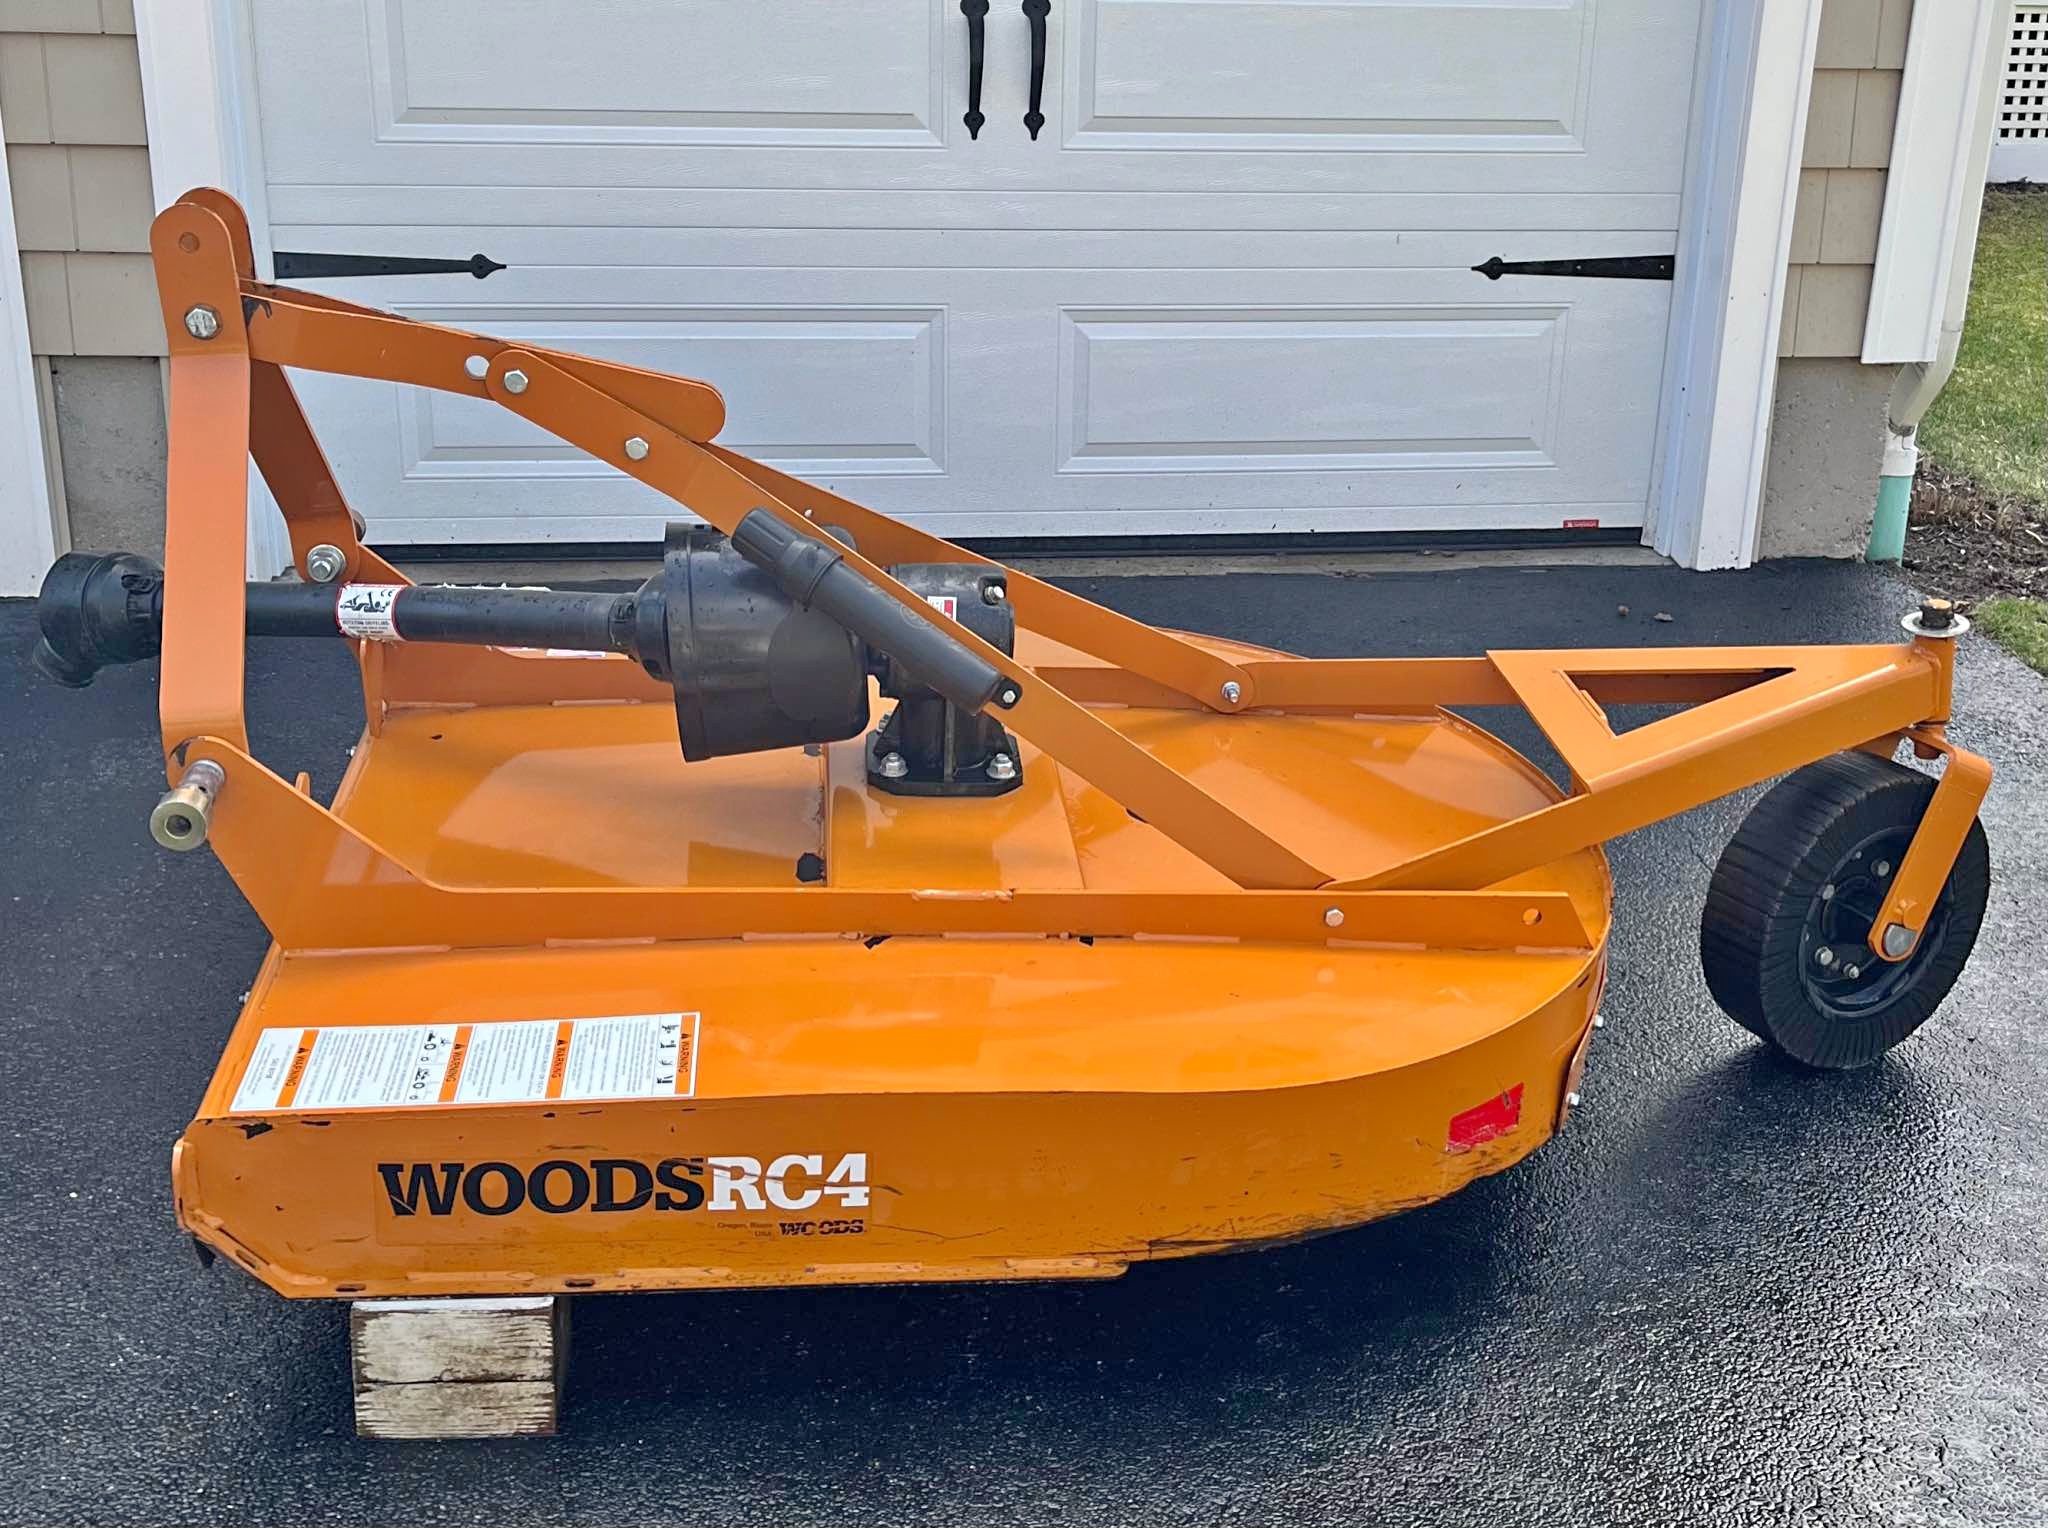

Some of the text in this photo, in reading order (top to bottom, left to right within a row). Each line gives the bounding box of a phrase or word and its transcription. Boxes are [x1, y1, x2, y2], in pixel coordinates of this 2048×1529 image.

[286, 1055, 306, 1087] WARNING
[446, 1051, 464, 1082] WARNING
[551, 1047, 565, 1078] WARNING
[678, 1040, 690, 1073] WARNING
[378, 1152, 870, 1216] WOODS RC4
